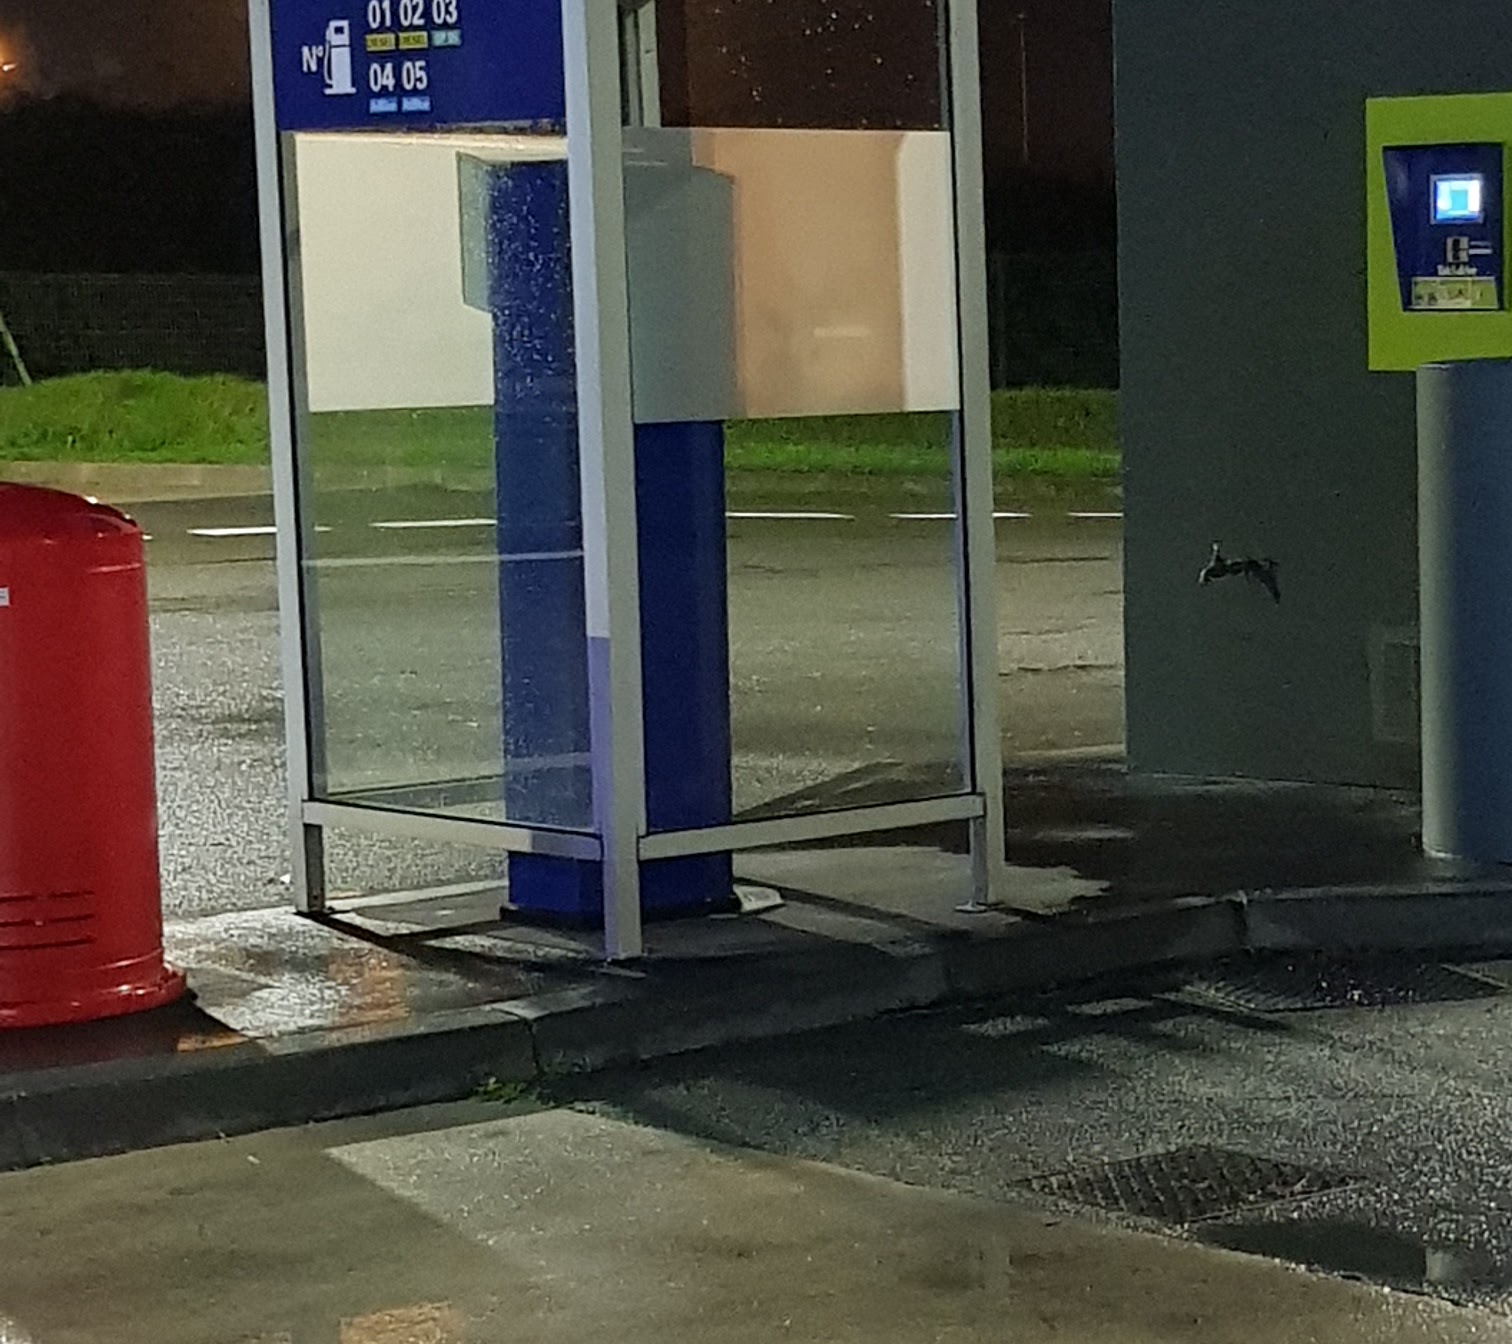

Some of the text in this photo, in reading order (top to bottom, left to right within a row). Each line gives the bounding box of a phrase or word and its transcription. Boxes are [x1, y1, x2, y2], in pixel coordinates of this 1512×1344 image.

[367, 0, 392, 29] 01
[368, 60, 428, 93] 04 05
